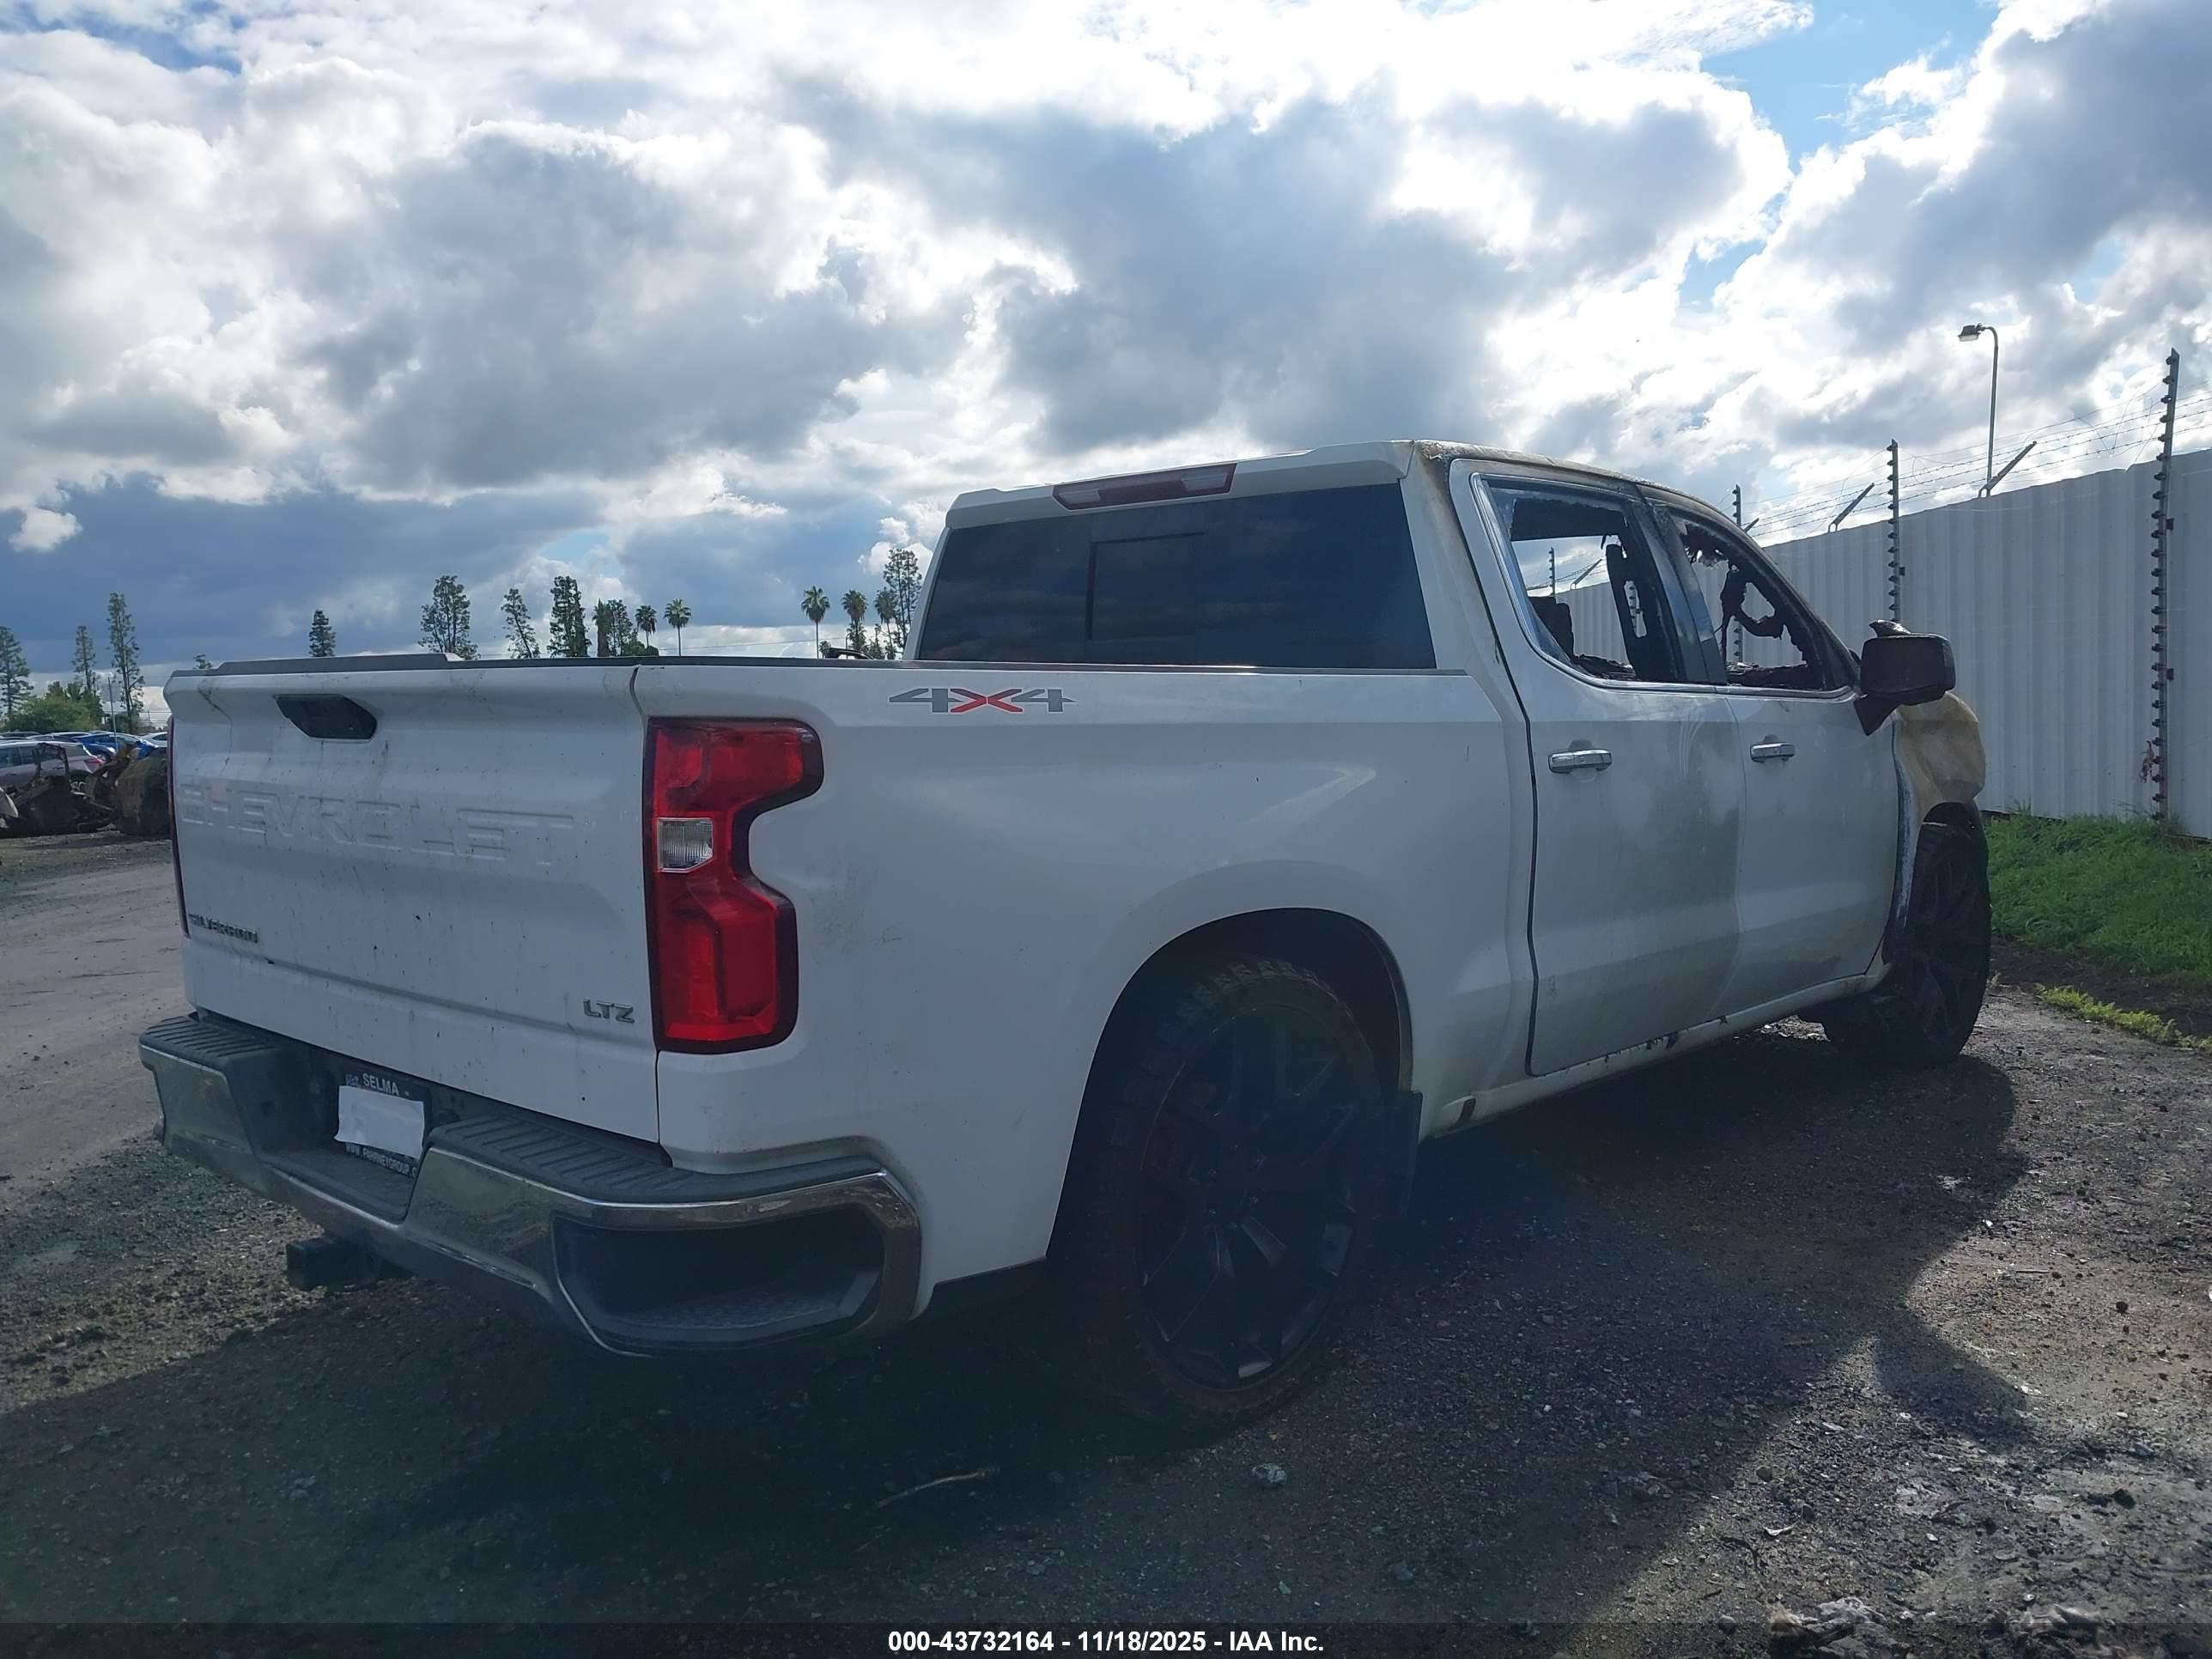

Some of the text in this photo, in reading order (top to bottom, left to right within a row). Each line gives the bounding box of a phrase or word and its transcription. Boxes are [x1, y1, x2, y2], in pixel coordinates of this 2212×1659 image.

[180, 783, 574, 866] CHEVROLET
[584, 999, 635, 1024] LTZ
[362, 1073, 399, 1097] SELMA
